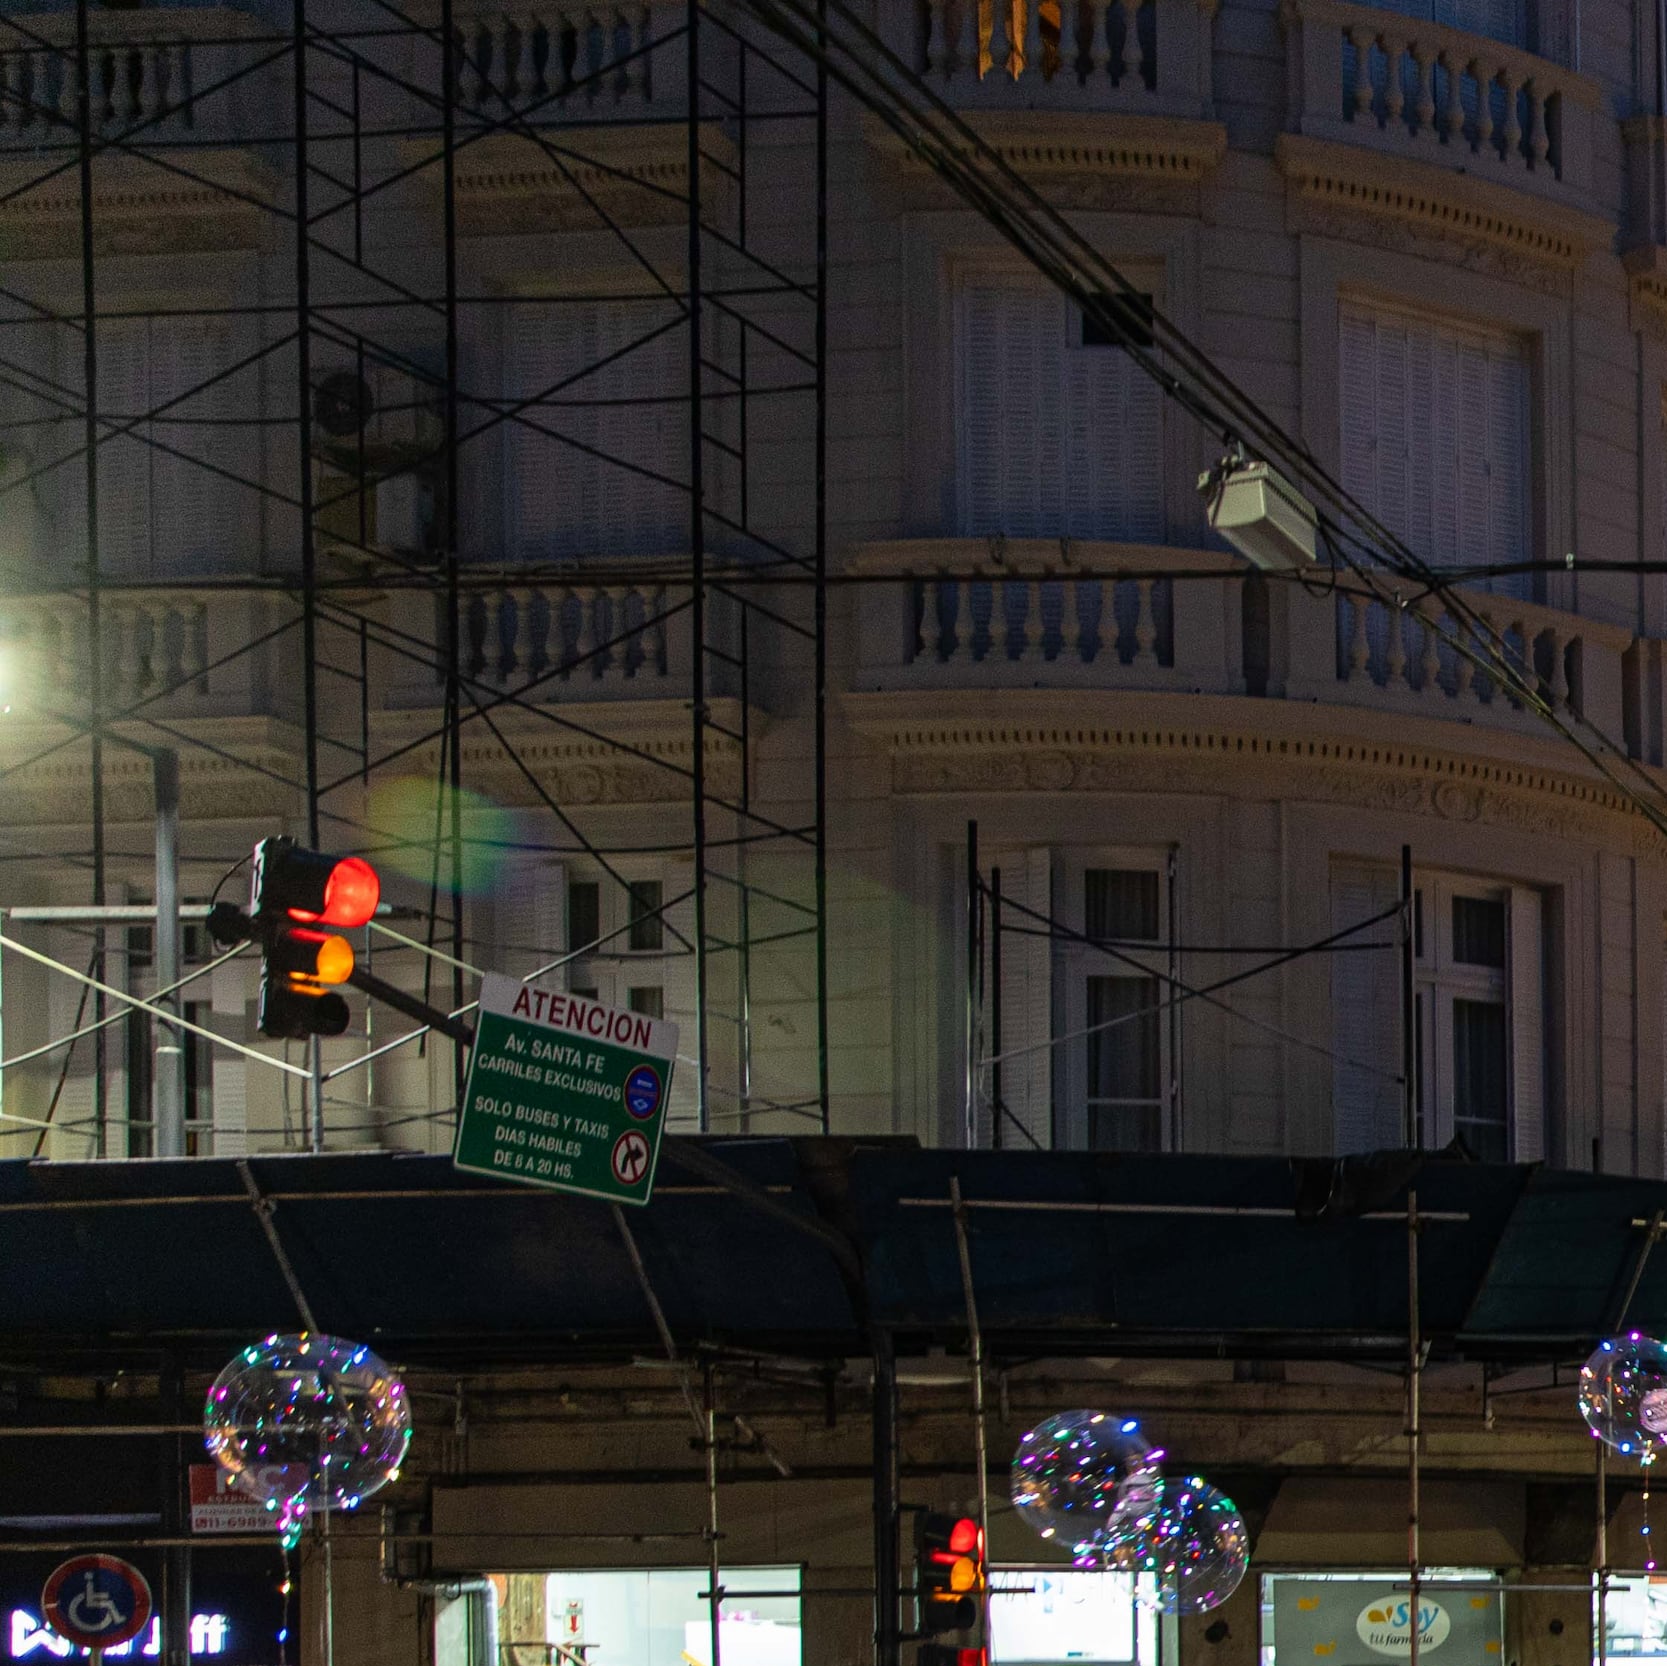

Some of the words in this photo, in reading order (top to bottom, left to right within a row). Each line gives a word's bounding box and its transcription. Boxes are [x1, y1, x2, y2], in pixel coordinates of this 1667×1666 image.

[512, 987, 651, 1048] ATENCION
[505, 1034, 527, 1054] Av.
[531, 1040, 581, 1068] SANTA
[585, 1055, 605, 1073] FE
[478, 1054, 542, 1083] CARRILES
[545, 1070, 621, 1101] EXCLUSIVOS
[475, 1096, 511, 1118] SOLO
[515, 1105, 559, 1128] BUSES
[563, 1116, 572, 1129] Y
[574, 1119, 609, 1139] TAXIS
[495, 1126, 525, 1144] DIAS
[529, 1134, 581, 1157] HABILES
[494, 1150, 512, 1167] DE
[525, 1157, 534, 1170] A
[538, 1158, 551, 1175] 20
[143, 1614, 230, 1655] Jff
